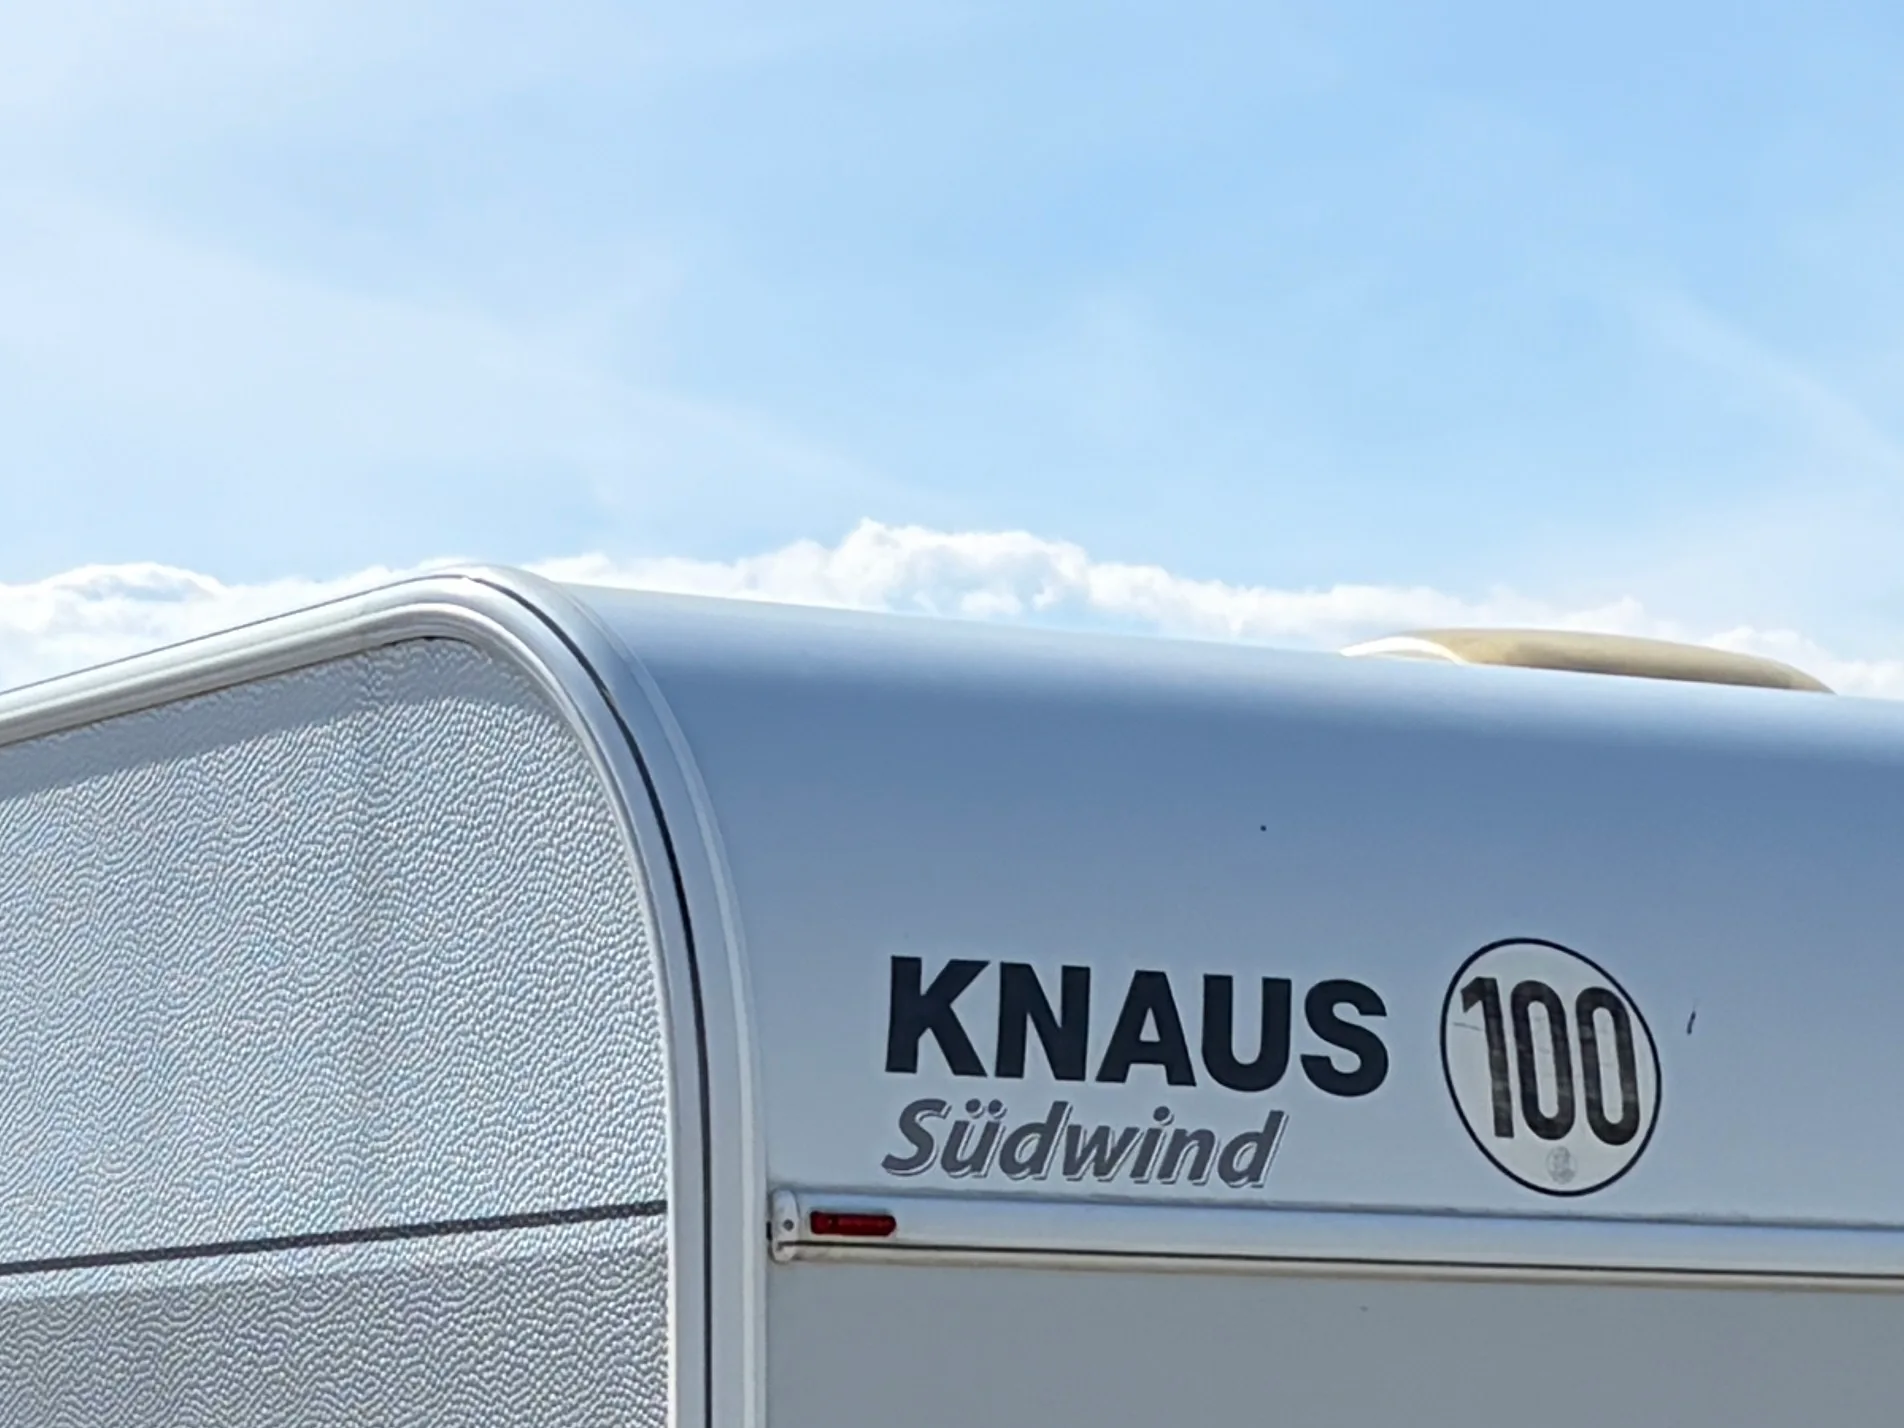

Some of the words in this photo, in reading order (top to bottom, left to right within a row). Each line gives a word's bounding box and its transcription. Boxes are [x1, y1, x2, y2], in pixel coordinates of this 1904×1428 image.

[885, 955, 1389, 1098] KNAUS
[1460, 976, 1640, 1146] 100
[881, 1098, 1289, 1188] Südwind
